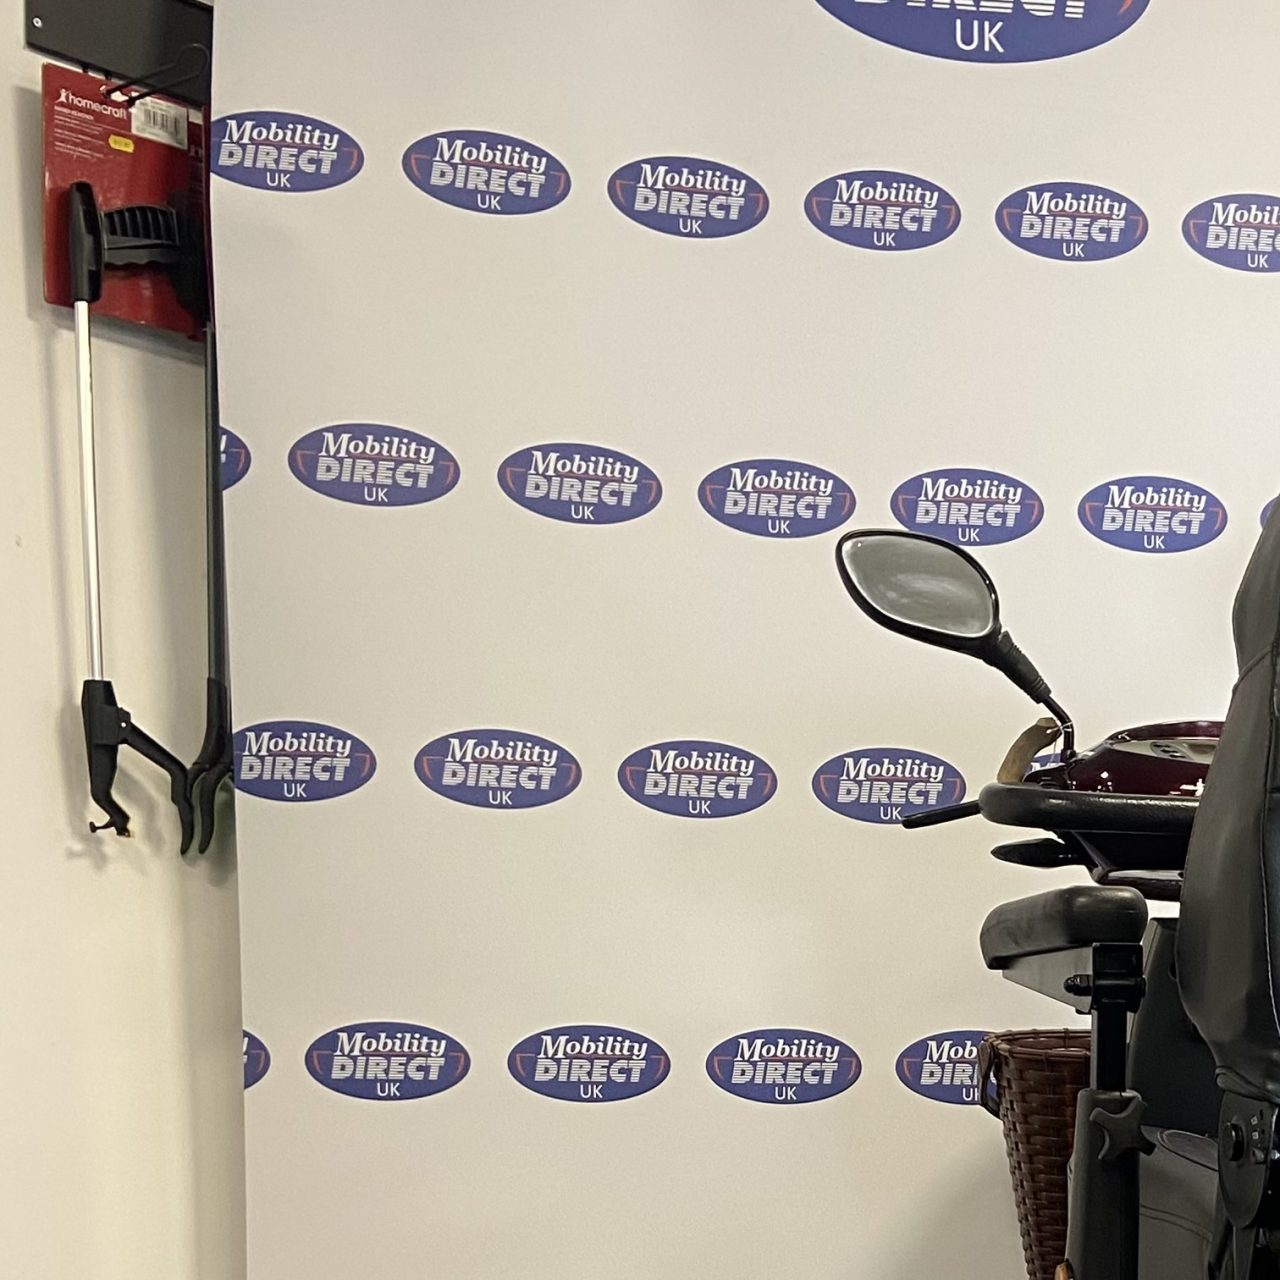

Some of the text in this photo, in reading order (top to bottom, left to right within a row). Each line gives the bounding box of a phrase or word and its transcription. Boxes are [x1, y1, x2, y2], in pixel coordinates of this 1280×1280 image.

[955, 18, 1004, 53] UK
[68, 92, 127, 120] homecraft
[221, 119, 340, 151] Mobility
[218, 143, 338, 175] DIRECT
[432, 137, 548, 174] Mobility
[266, 171, 291, 188] UK
[429, 161, 546, 198] DIRECT
[636, 163, 747, 197] Mobility
[477, 193, 501, 211] UK
[634, 187, 746, 220] DIRECT
[832, 179, 939, 209] Mobility
[1022, 190, 1127, 220] Mobility
[679, 217, 702, 235] UK
[829, 203, 938, 232] DIRECT
[1020, 214, 1126, 243] DIRECT
[873, 231, 896, 247] UK
[1062, 242, 1085, 258] UK
[1247, 253, 1269, 269] UK
[318, 431, 436, 465] Mobility
[316, 456, 435, 489] DIRECT
[527, 450, 640, 484] Mobility
[364, 485, 389, 503] UK
[525, 474, 638, 507] DIRECT
[726, 467, 834, 497] Mobility
[917, 477, 1023, 505] Mobility
[723, 491, 833, 519] DIRECT
[1104, 485, 1207, 513] Mobility
[571, 504, 595, 521] UK
[915, 500, 1022, 528] DIRECT
[1102, 508, 1206, 535] DIRECT
[767, 519, 791, 534] UK
[958, 527, 980, 542] UK
[1143, 534, 1166, 550] UK
[242, 731, 352, 758] Mobility
[444, 737, 559, 767] Mobility
[240, 756, 351, 782] DIRECT
[441, 762, 557, 790] DIRECT
[646, 749, 755, 777] Mobility
[839, 757, 945, 783] Mobility
[283, 782, 307, 798] UK
[488, 789, 513, 805] UK
[643, 772, 754, 800] DIRECT
[837, 780, 944, 805] DIRECT
[688, 799, 711, 815] UK
[880, 806, 902, 820] UK
[333, 1032, 447, 1058] Mobility
[536, 1035, 648, 1060] Mobility
[733, 1038, 840, 1063] Mobility
[331, 1056, 446, 1081] DIRECT
[534, 1058, 647, 1083] DIRECT
[731, 1061, 839, 1085] DIRECT
[376, 1082, 401, 1097] UK
[580, 1084, 603, 1099] UK
[774, 1086, 797, 1101] UK
